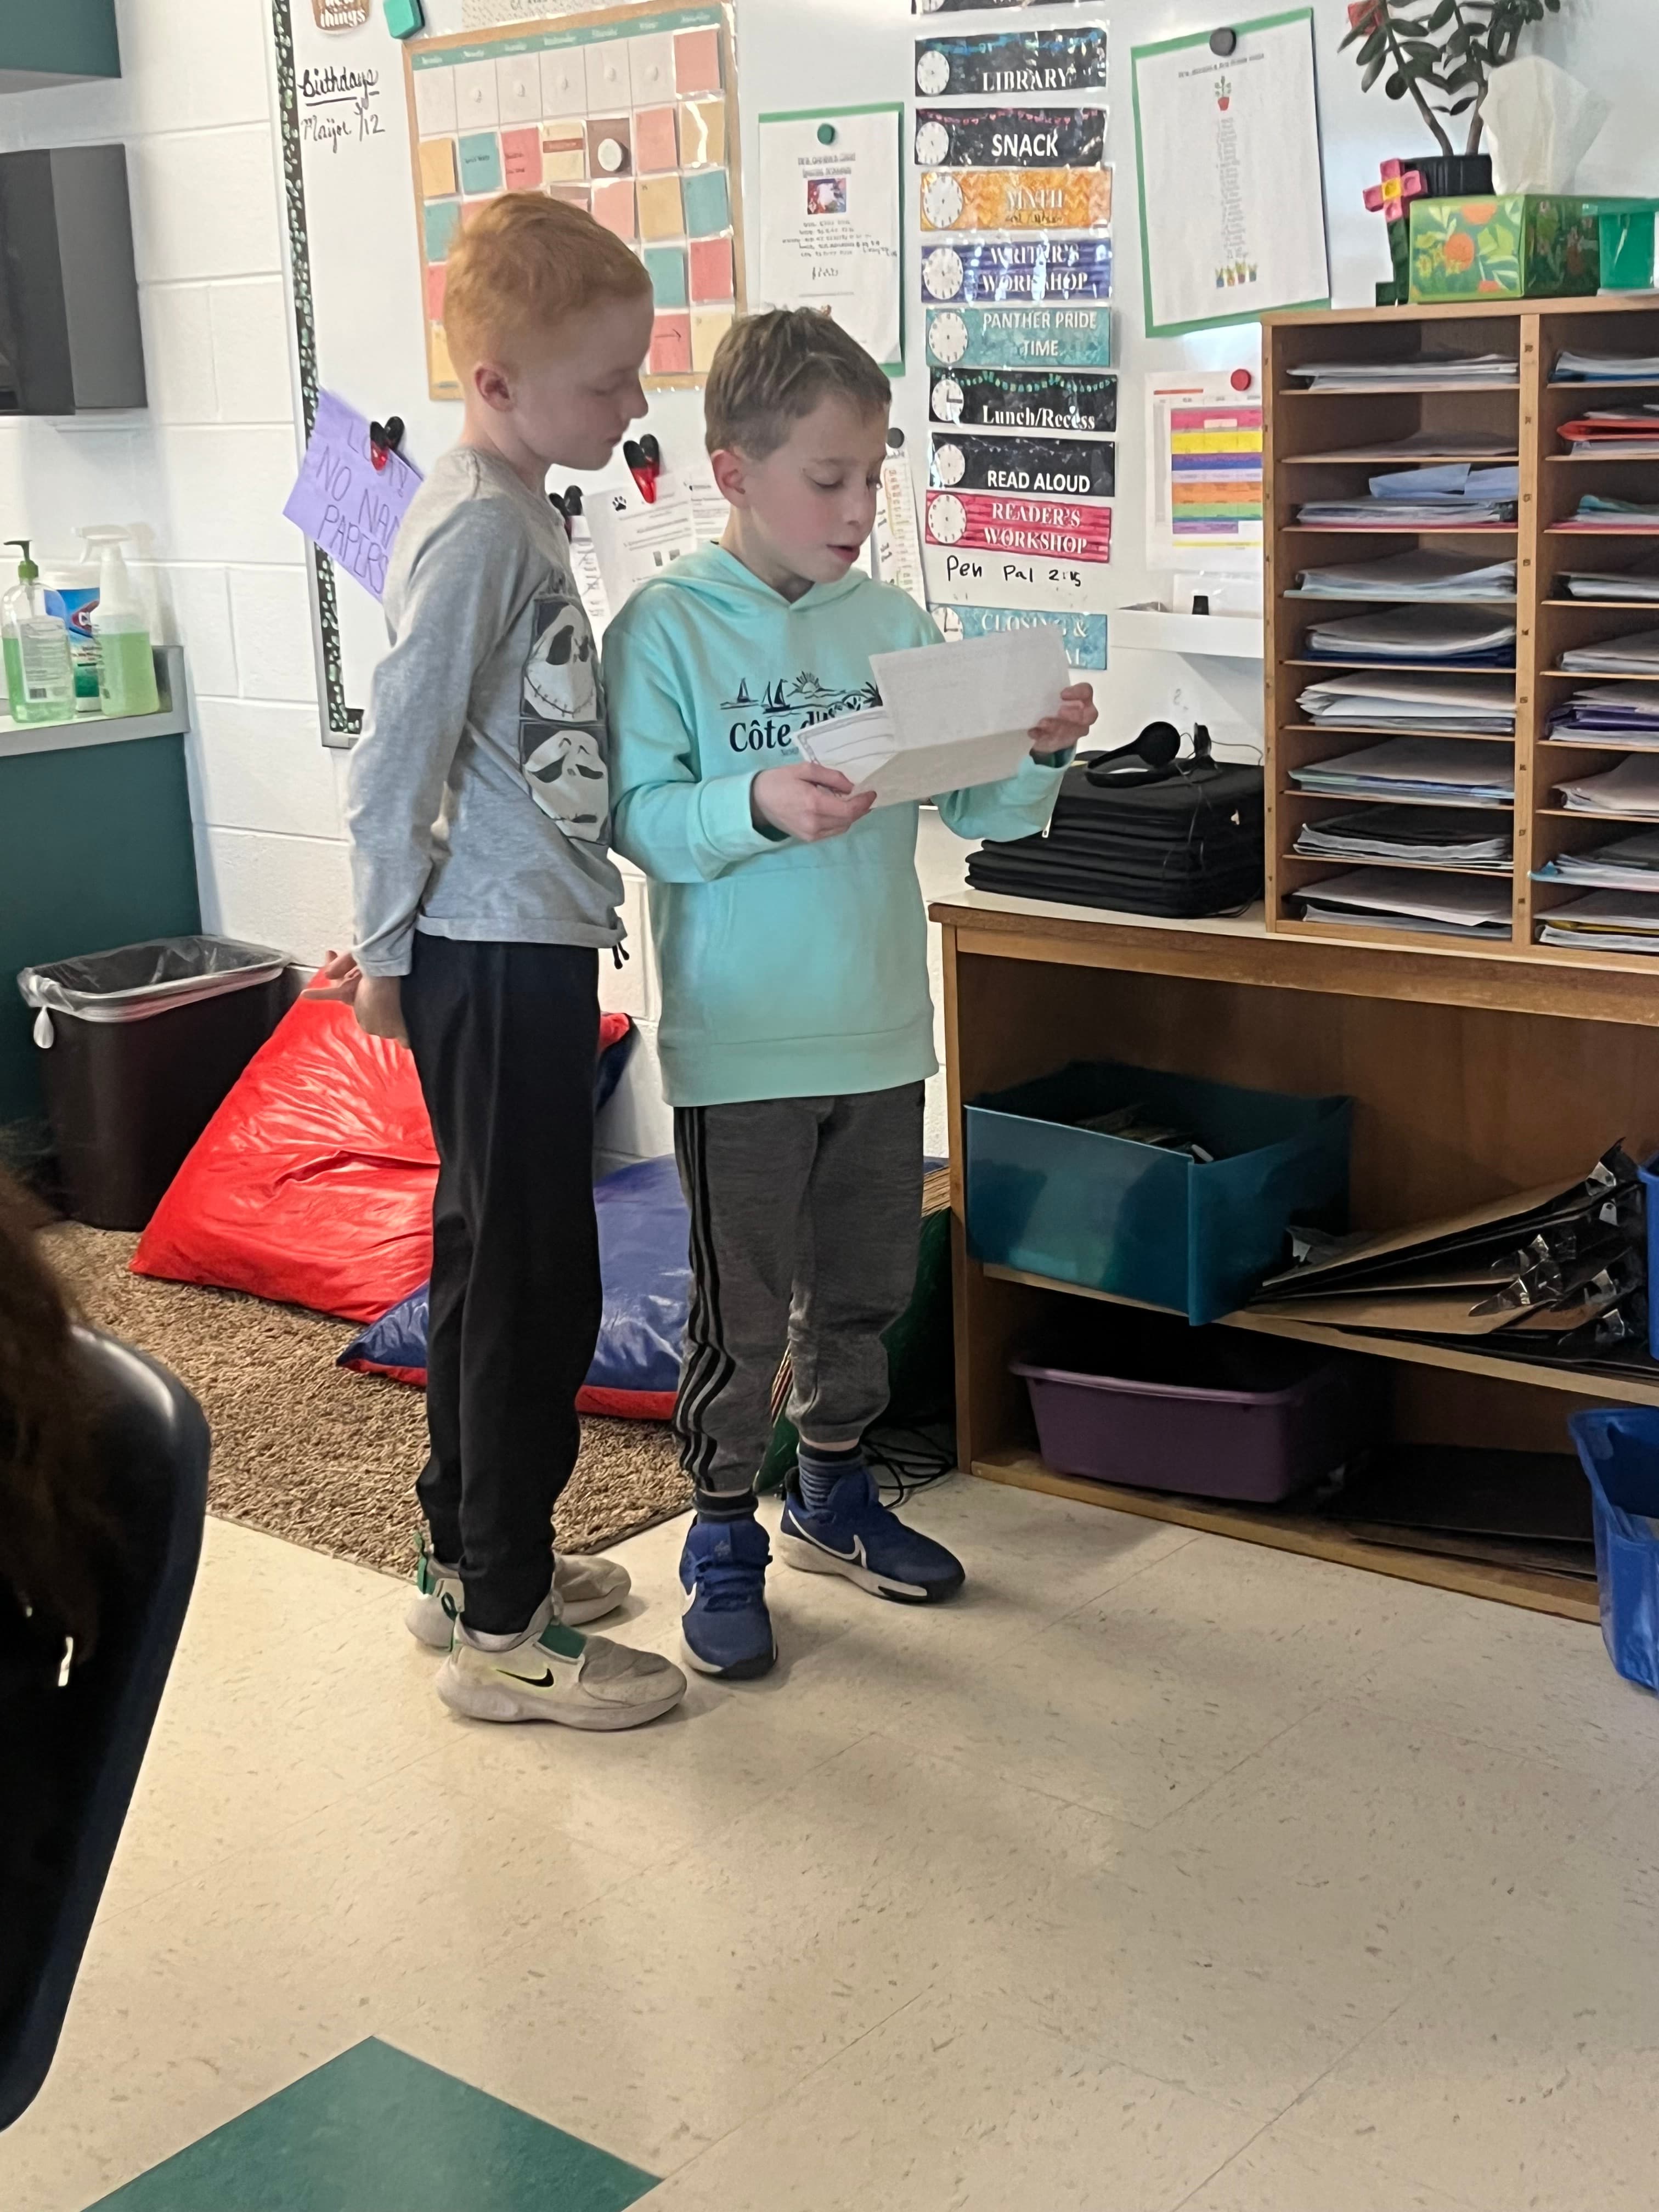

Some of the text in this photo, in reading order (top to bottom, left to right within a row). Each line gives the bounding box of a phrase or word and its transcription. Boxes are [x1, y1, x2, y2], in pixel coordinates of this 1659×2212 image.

[320, 9, 366, 27] things
[297, 66, 379, 104] Birthdays
[983, 68, 1070, 92] LIBRARY
[991, 132, 1058, 157] SNACK
[983, 272, 1087, 293] WORHOP
[983, 311, 1097, 329] PANTHER PRIDE
[1023, 339, 1059, 356] TIME
[983, 405, 1095, 430] Lunch/Recess
[316, 445, 351, 501] NO
[988, 470, 1091, 493] READ ALOUD
[992, 503, 1081, 527] READER'S
[317, 505, 388, 594] PAPERS
[984, 527, 1087, 554] WORKSHOP
[946, 555, 983, 582] Pen
[1003, 565, 1033, 583] Pal
[1073, 619, 1088, 637] &
[730, 720, 792, 752] Côte
